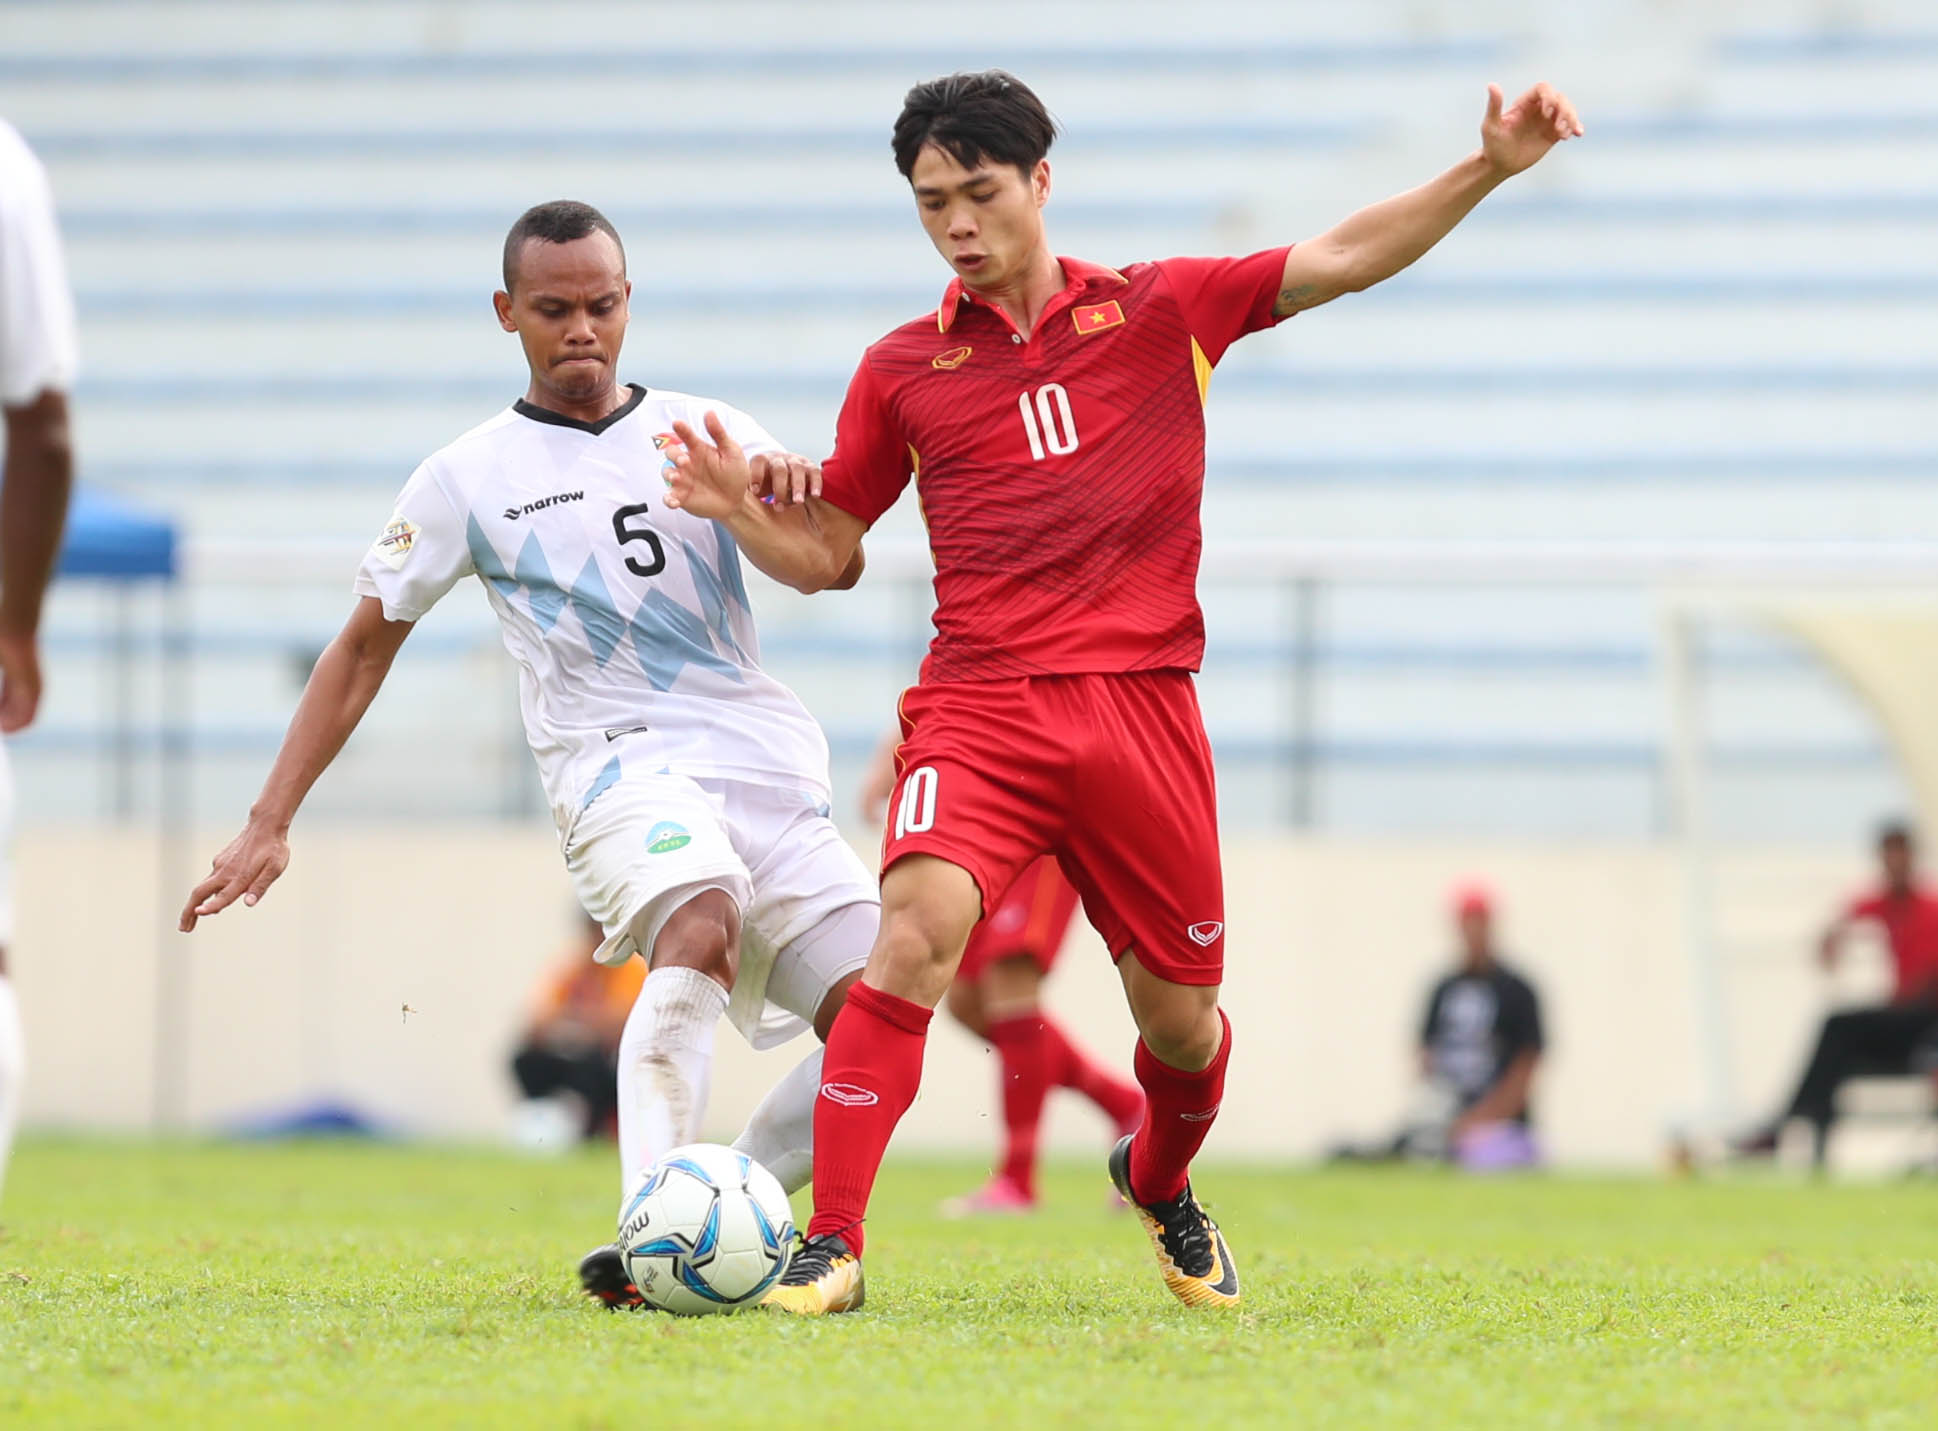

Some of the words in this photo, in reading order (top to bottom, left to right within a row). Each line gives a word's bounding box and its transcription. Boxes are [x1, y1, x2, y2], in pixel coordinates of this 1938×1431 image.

[1018, 383, 1080, 461] 10
[523, 490, 584, 515] narrow
[612, 502, 666, 578] 5
[895, 766, 939, 841] 10
